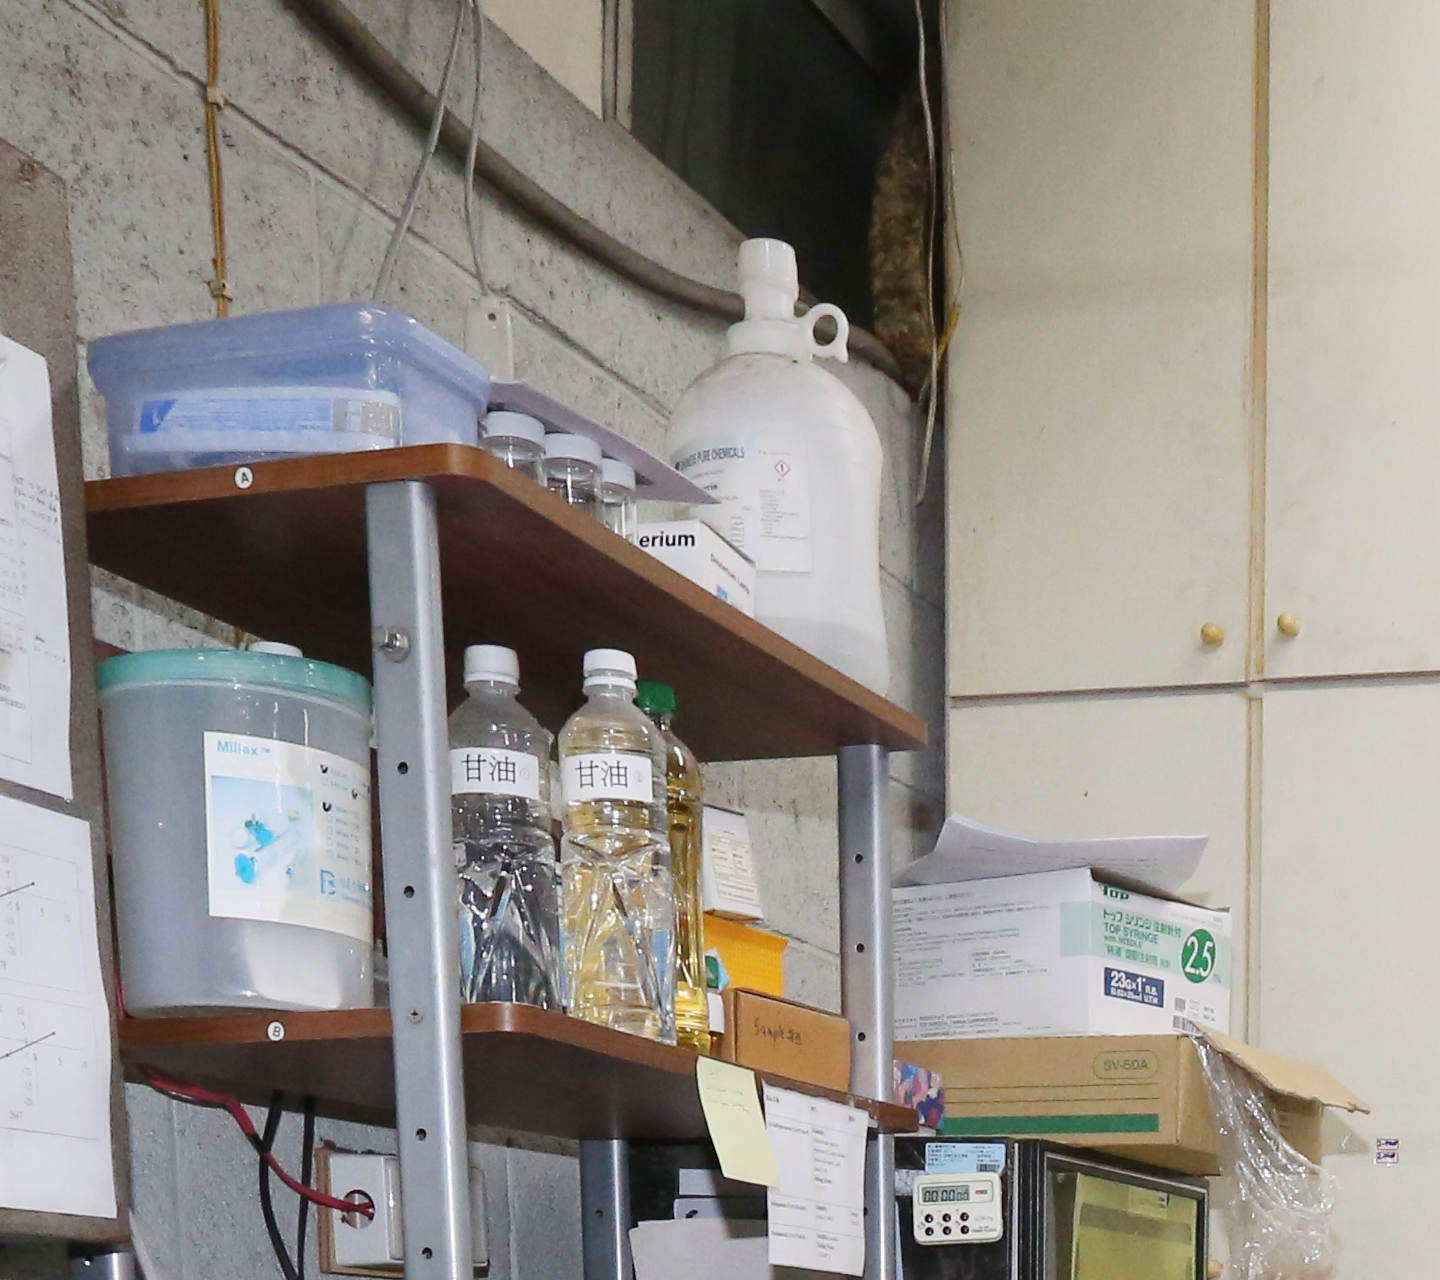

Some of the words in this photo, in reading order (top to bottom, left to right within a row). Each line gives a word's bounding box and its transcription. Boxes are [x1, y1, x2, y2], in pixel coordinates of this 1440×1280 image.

[240, 472, 250, 484] A
[639, 531, 696, 548] erium
[461, 754, 516, 784] 甘油
[575, 760, 629, 788] 甘油
[1104, 922, 1122, 935] TOP
[1123, 925, 1159, 944] SYRINGE
[1184, 935, 1214, 977] 2.5
